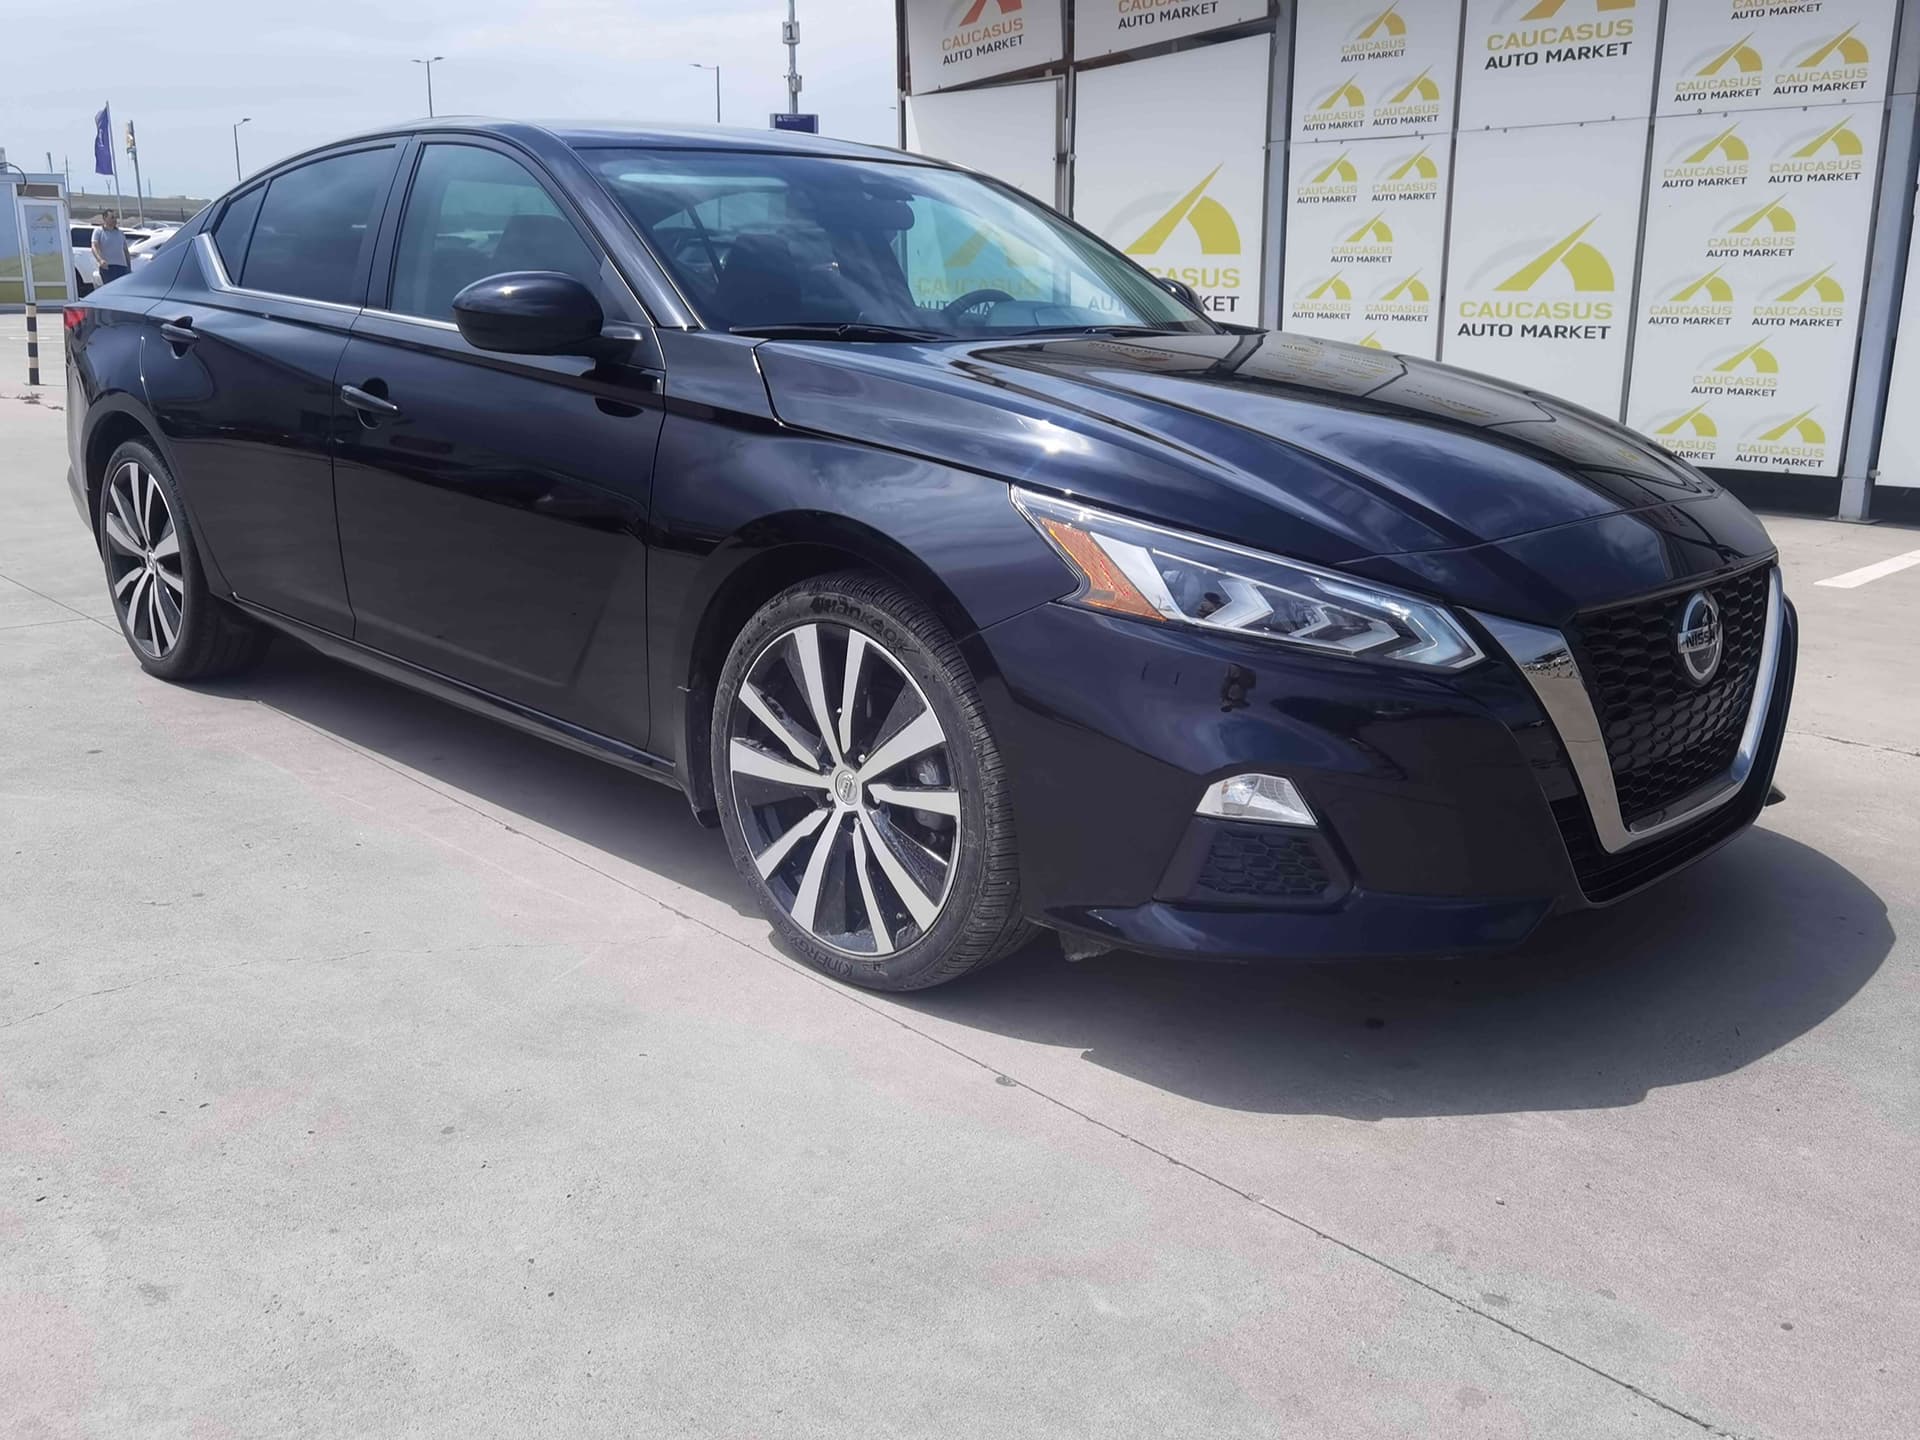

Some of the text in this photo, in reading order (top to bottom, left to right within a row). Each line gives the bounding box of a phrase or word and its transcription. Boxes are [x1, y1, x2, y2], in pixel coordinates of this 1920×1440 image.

[1118, 1, 1218, 30] AUTO MARKET
[1733, 3, 1822, 20] AUTO MARKET
[786, 24, 796, 41] 1
[942, 18, 1023, 51] CAUCASUS
[1487, 19, 1633, 51] CAUCASUS
[943, 35, 1023, 65] AUTO MARKET
[1341, 38, 1406, 53] CAUCASUS
[1341, 49, 1405, 63] AUTO MARKET
[1485, 41, 1632, 70] AUTO MARKET
[1775, 68, 1868, 84] CAUCASUS
[1676, 77, 1762, 92] CAUCASUS
[1773, 80, 1868, 95] AUTO MARKET
[1674, 88, 1761, 102] AUTO MARKET
[1303, 110, 1365, 123] CAUCASUS
[1374, 104, 1439, 118] CAUCASUS
[1303, 119, 1364, 132] AUTO MARKET
[1373, 114, 1439, 126] AUTO MARKET
[1664, 164, 1748, 178] CAUCASUS
[1770, 160, 1862, 173] CAUCASUS
[1662, 176, 1748, 188] AUTO MARKET
[1768, 172, 1862, 184] AUTO MARKET
[1297, 184, 1357, 196] CAUCASUS
[1372, 182, 1437, 194] CAUCASUS
[1297, 194, 1357, 204] AUTO MARKET
[1372, 192, 1437, 201] AUTO MARKET
[1708, 237, 1795, 247] CAUCASUS
[1331, 246, 1392, 254] CAUCASUS
[1706, 248, 1794, 257] AUTO MARKET
[1357, 255, 1392, 263] MARKET
[1292, 303, 1351, 311] CAUCASUS
[1365, 304, 1429, 313] CAUCASUS
[1459, 301, 1612, 319] CAUCASUS
[1650, 306, 1732, 316] CAUCASUS
[1752, 306, 1843, 317] CAUCASUS
[1292, 311, 1350, 320] AUTO MARKET
[1365, 313, 1428, 322] AUTO MARKET
[1683, 317, 1732, 325] MARKET
[1752, 318, 1843, 327] AUTO MARKET
[1458, 323, 1611, 339] AUTO MARKET
[1692, 376, 1777, 387] CAUCASUS
[1691, 386, 1776, 397] AUTO MARKET
[1737, 443, 1824, 457] CAUCASUS
[1735, 454, 1823, 468] AUTO MARKET
